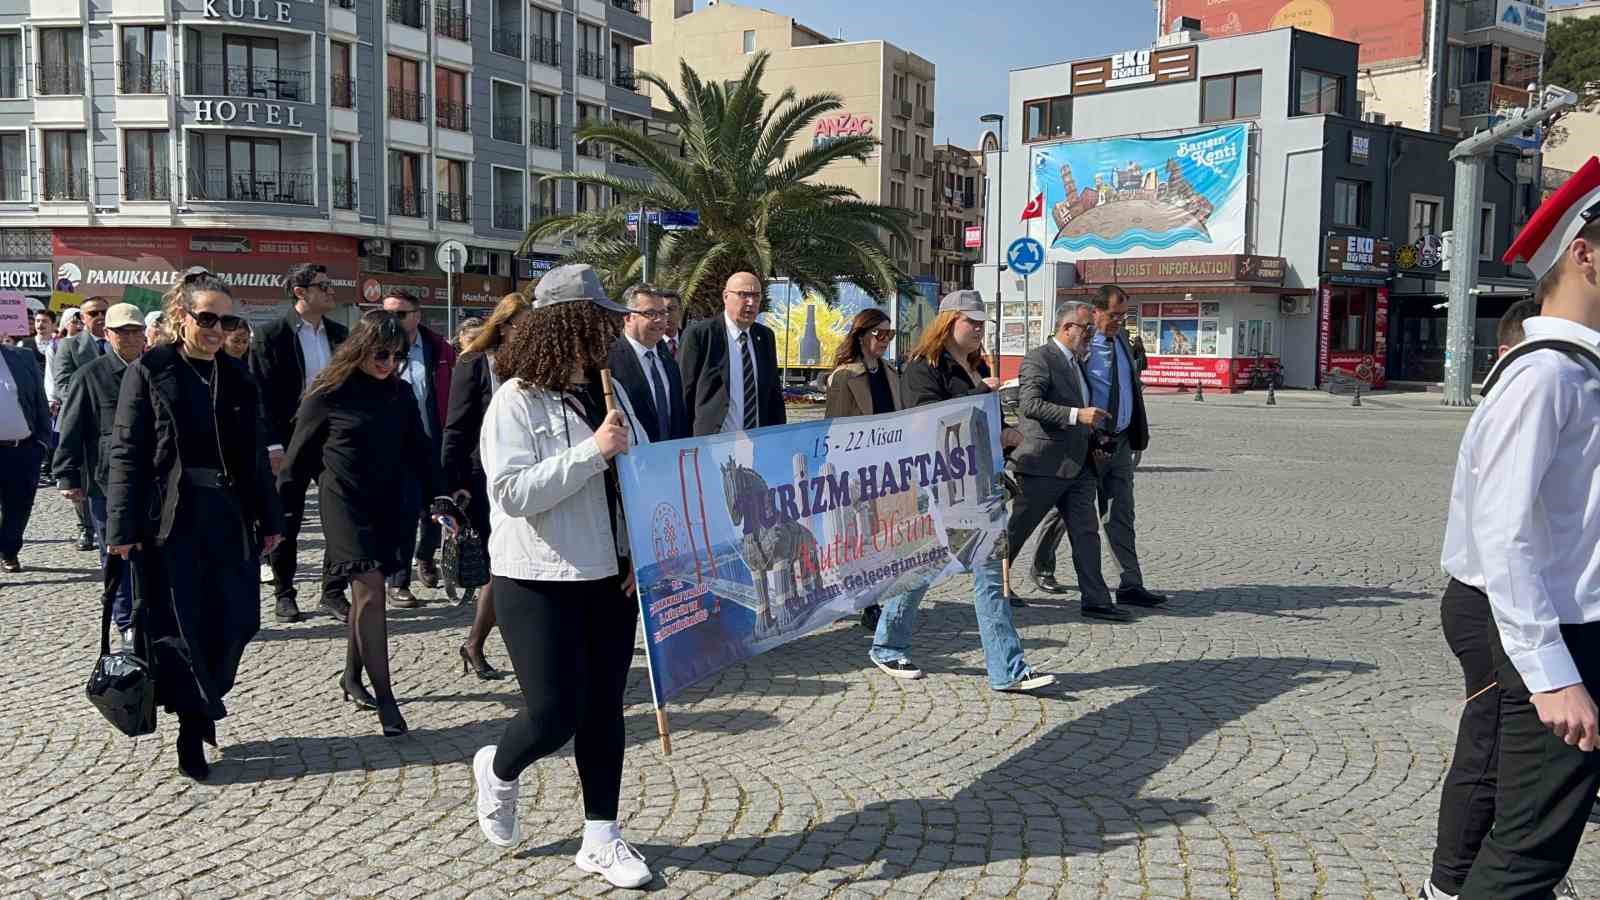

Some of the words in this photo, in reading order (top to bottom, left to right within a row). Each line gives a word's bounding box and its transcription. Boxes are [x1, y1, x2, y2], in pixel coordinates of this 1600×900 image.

[202, 0, 292, 23] KULE
[1111, 50, 1151, 69] EKO
[194, 100, 302, 127] HOTEL
[815, 113, 872, 137] ANZAC
[1191, 142, 1237, 167] Kenti
[1347, 236, 1374, 253] EKO
[0, 271, 46, 288] HOTEL
[86, 270, 179, 285] PAMUKKALE
[1110, 263, 1152, 277] TOURIST
[1158, 260, 1232, 276] INFORMATION
[813, 436, 830, 458] 15
[845, 430, 864, 452] 22
[867, 425, 903, 448] Nisan
[736, 469, 850, 535] TURİZM
[858, 445, 979, 501] HAFTASI
[795, 519, 864, 578] Kutlu
[871, 509, 935, 552] Olsun
